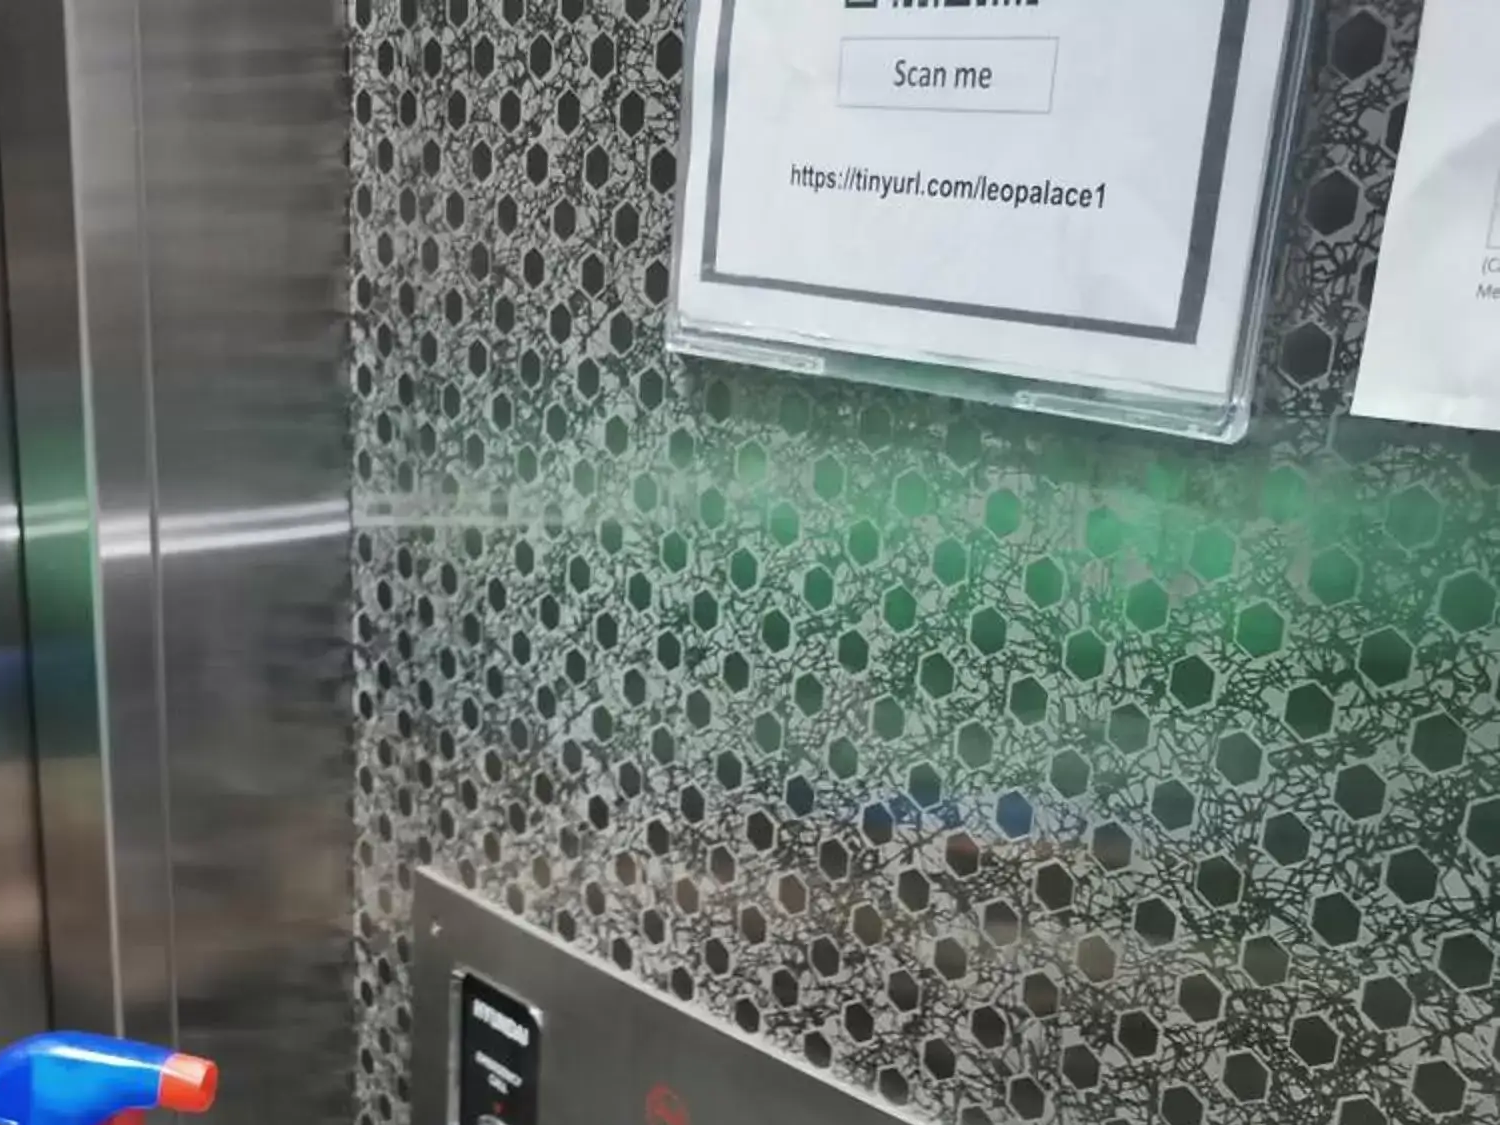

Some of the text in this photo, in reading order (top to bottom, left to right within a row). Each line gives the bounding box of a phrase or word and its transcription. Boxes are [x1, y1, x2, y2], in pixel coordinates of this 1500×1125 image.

[893, 59, 993, 89] Scan me
[789, 163, 1107, 209] https://tinyurl.com/leopalace1
